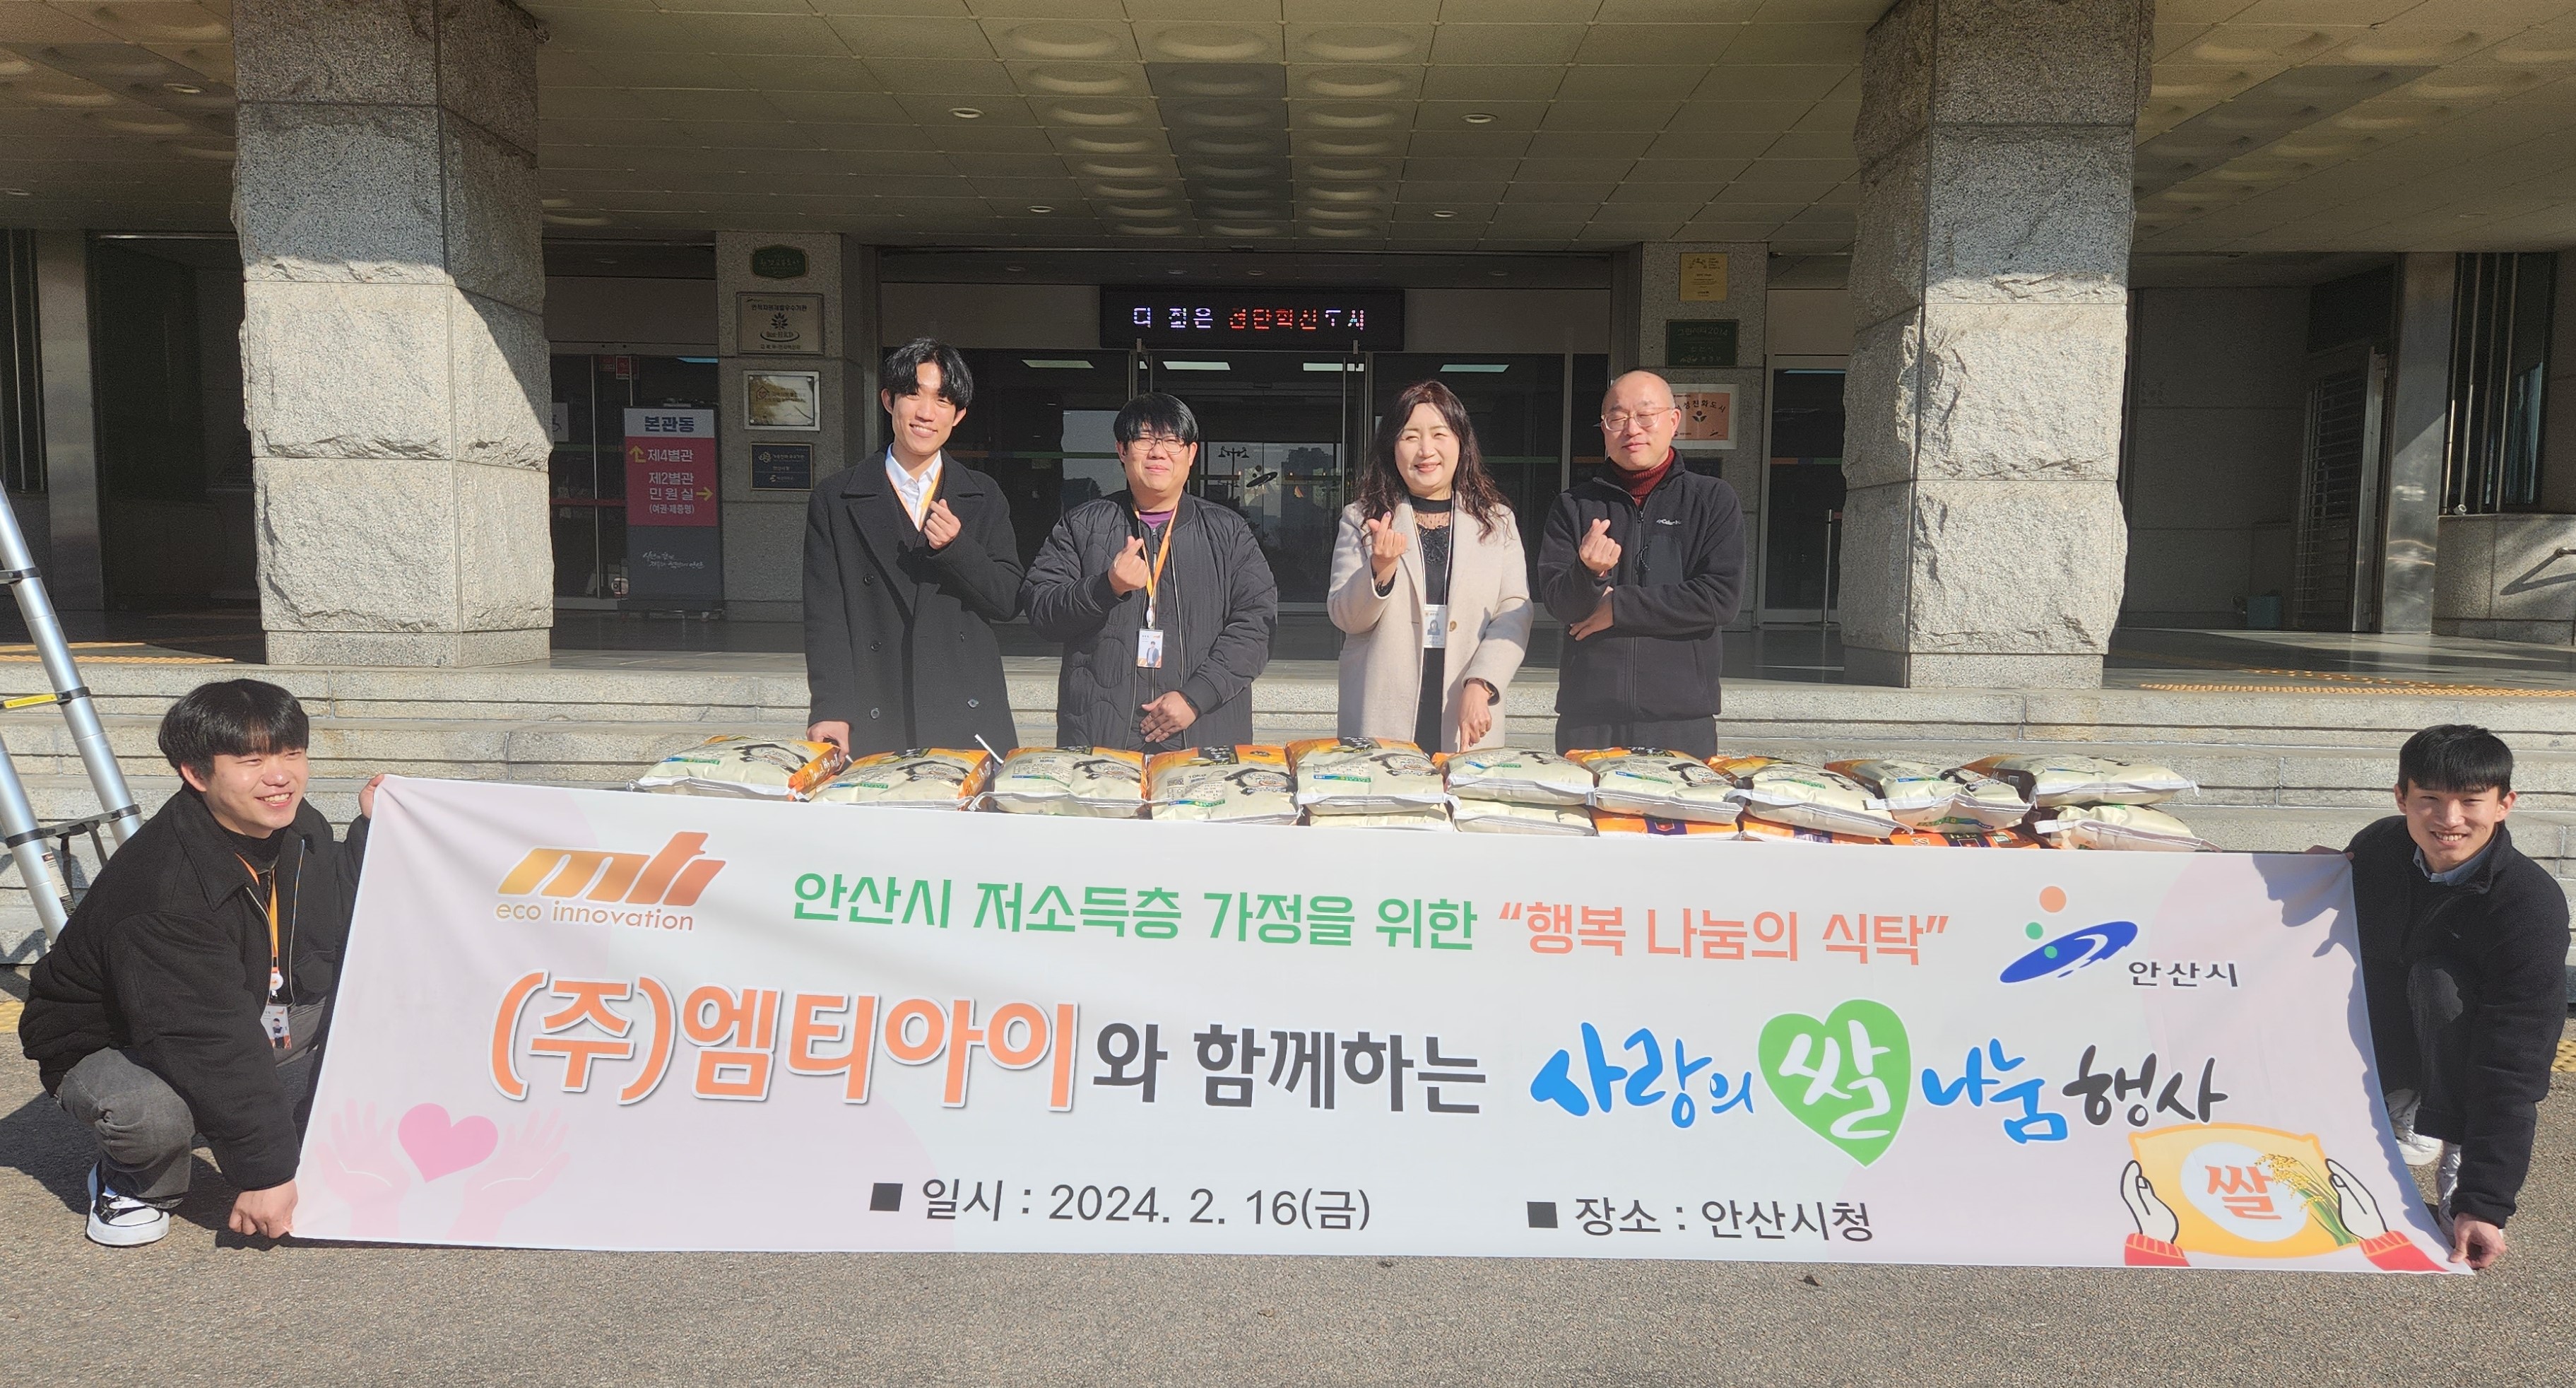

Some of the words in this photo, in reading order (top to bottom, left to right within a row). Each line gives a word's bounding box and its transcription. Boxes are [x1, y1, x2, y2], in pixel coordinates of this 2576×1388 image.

[645, 416, 695, 433] 본관동
[648, 449, 693, 462] 제4별관
[649, 471, 694, 485] 제2별관
[495, 903, 541, 920] eco
[553, 900, 693, 931] innovation
[794, 873, 951, 929] 안산시
[974, 883, 1181, 939] 저소득층
[1204, 892, 1354, 946] 가정을
[1376, 898, 1477, 950] 위한
[1648, 908, 1798, 962] 나눔의
[2128, 962, 2238, 987] 안산시
[1193, 1024, 1486, 1114] 함께하는
[1530, 1022, 1754, 1129] 사랑의
[1778, 1019, 1891, 1140] 쌀
[1921, 1038, 2069, 1144] 나눔
[2062, 1045, 2228, 1127] 행사
[922, 1179, 1003, 1221] 일시
[1049, 1184, 1169, 1223] 2024.
[1190, 1188, 1225, 1224] 2.
[1246, 1188, 1370, 1230] 16(금)
[2204, 1165, 2282, 1221] 쌀
[1576, 1197, 1661, 1236] 장소
[1701, 1199, 1873, 1242] 안산시청
